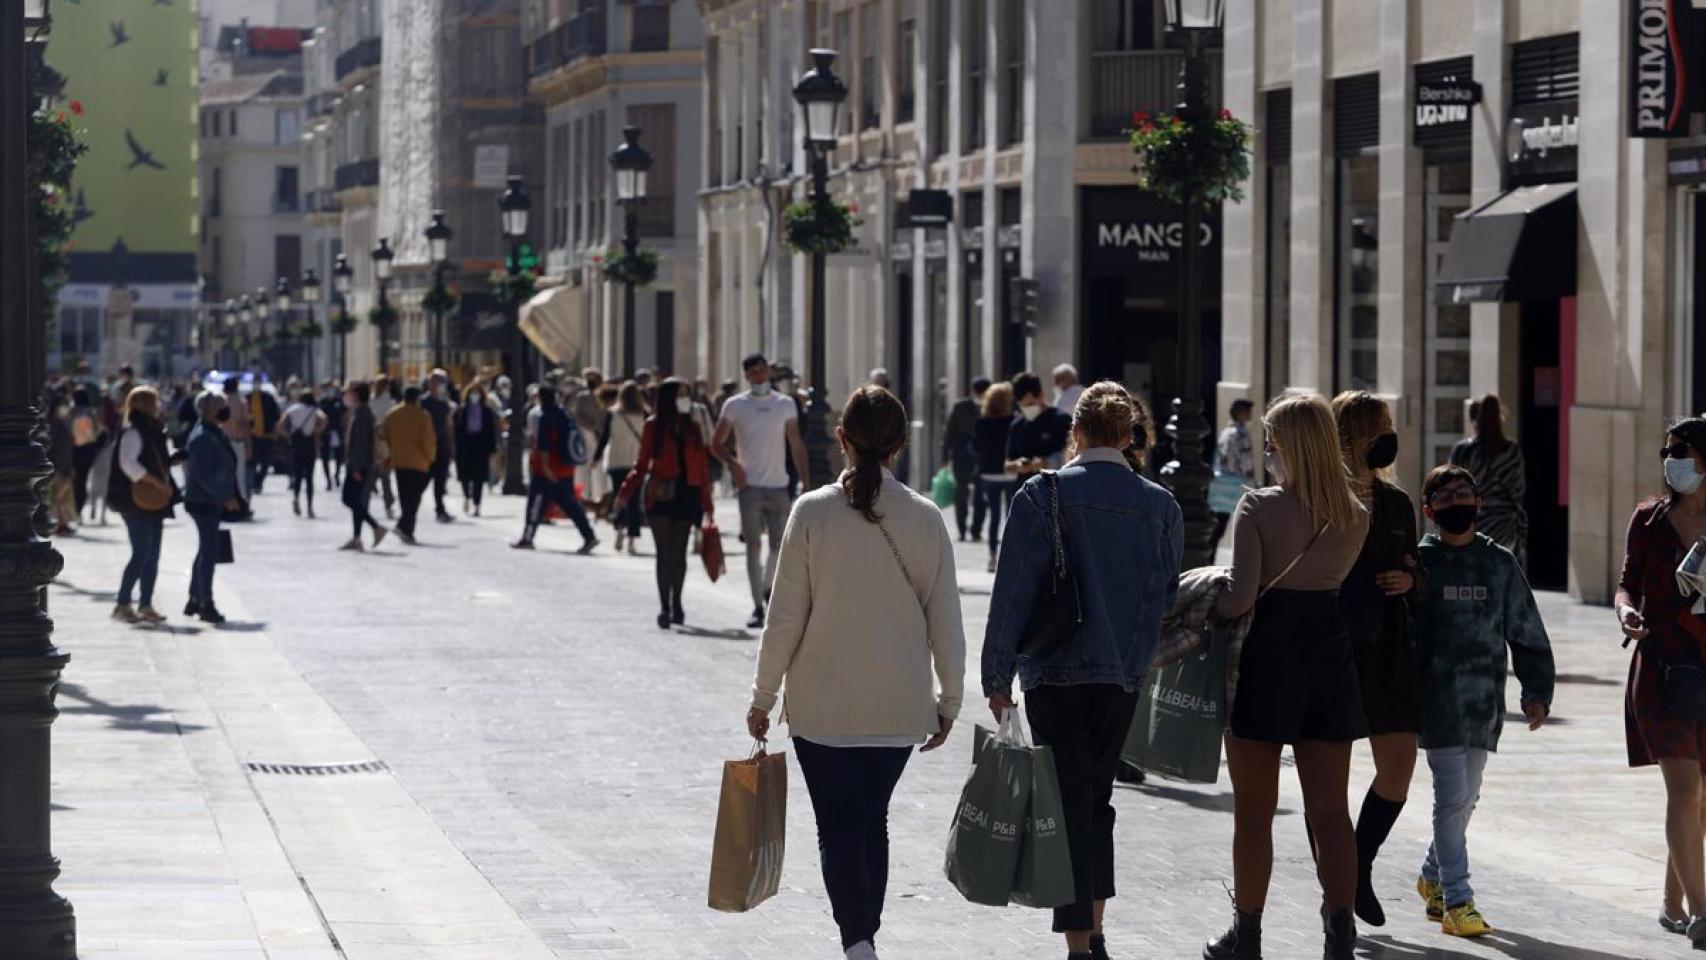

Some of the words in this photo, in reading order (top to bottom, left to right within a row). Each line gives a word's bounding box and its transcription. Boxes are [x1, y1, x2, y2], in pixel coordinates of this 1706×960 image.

[1419, 86, 1472, 102] Bershka
[1138, 250, 1170, 261] MAN
[993, 821, 1016, 835] P&B
